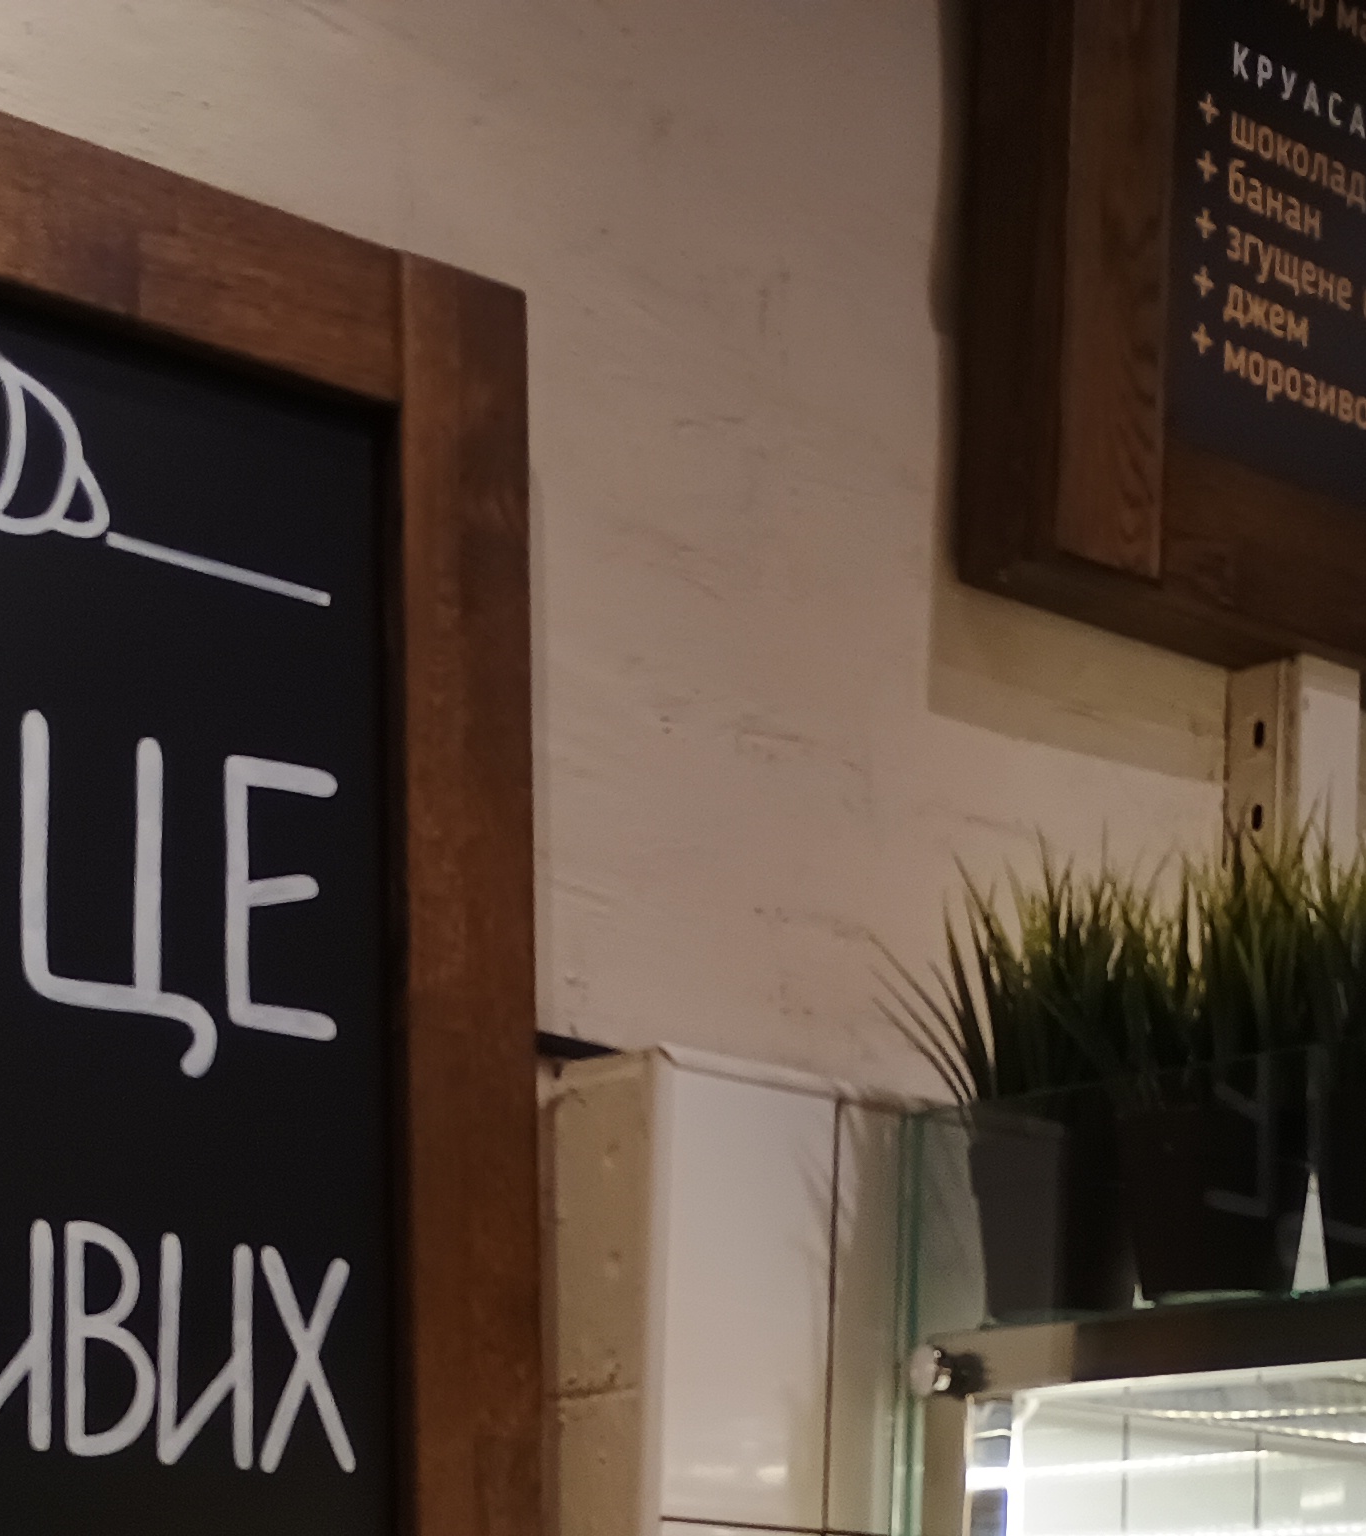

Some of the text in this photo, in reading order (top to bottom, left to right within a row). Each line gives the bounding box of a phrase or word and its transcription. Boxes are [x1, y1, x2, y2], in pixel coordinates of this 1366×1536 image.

[1228, 158, 1322, 241] банан
[1230, 111, 1366, 214] шоколад
[1226, 225, 1353, 311] згущене
[1223, 283, 1309, 348] джем
